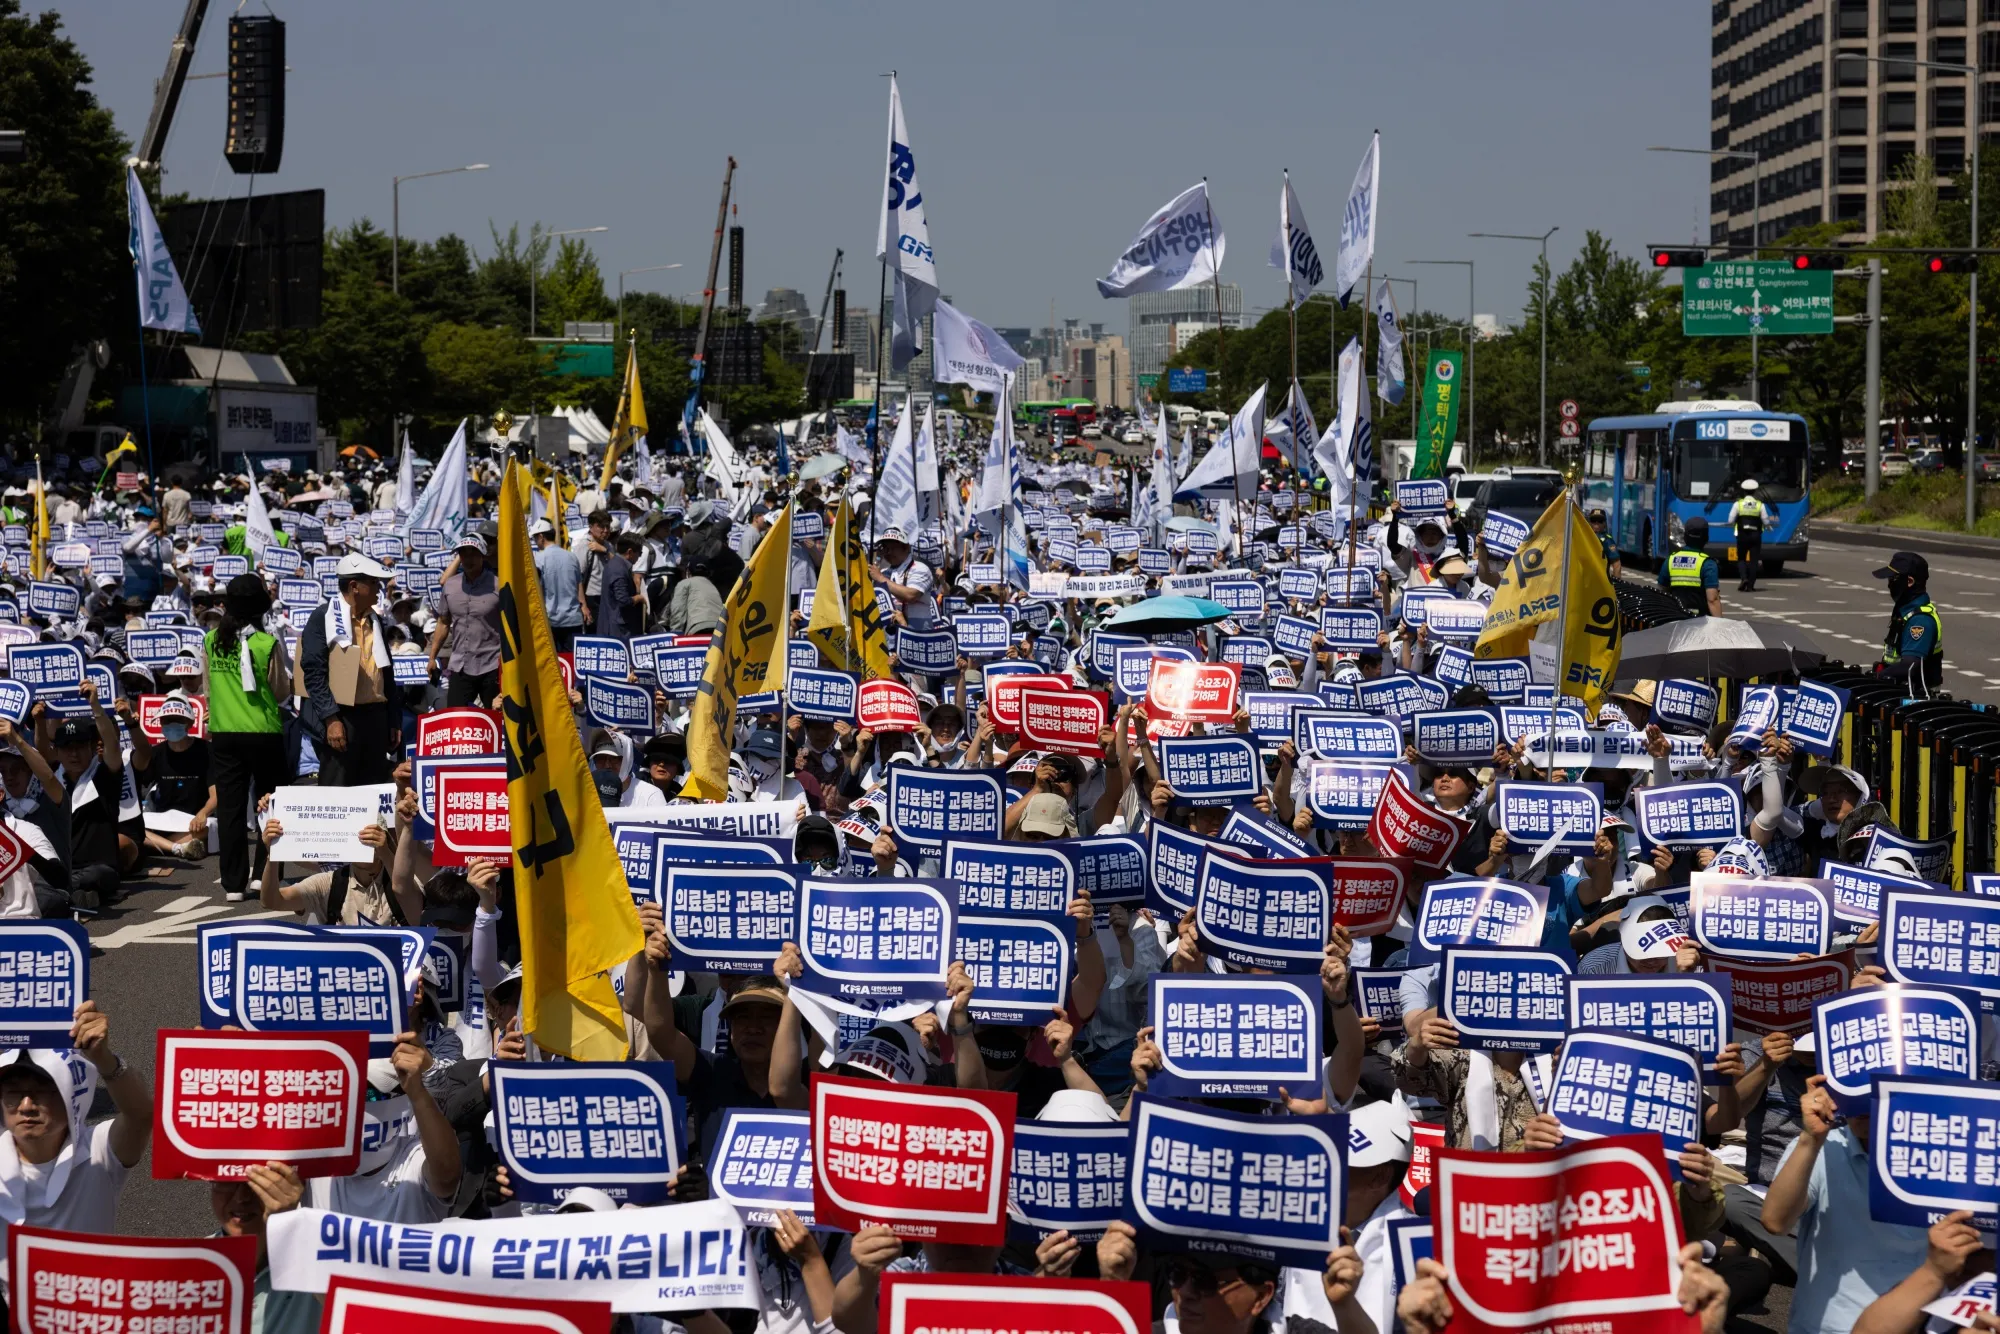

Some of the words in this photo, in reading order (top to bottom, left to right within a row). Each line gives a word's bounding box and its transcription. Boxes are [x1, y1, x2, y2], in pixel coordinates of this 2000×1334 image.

[1712, 264, 1735, 276] 시청
[1759, 267, 1775, 275] City
[1714, 277, 1755, 288] 강변북로
[1687, 300, 1732, 311] 국회의사당
[1782, 297, 1830, 308] 여의나루역
[1699, 423, 1725, 438] 160
[1325, 617, 1350, 627] 의료농단
[1352, 618, 1376, 628] 교육농단
[1325, 628, 1350, 638] 필수의료
[1352, 629, 1376, 639] 붕괴된다
[14, 656, 41, 670] 의료농단
[44, 654, 77, 668] 교육농단
[576, 646, 598, 658] 의료농단
[599, 648, 626, 660] 교육농단
[15, 670, 43, 683] 필수의료
[46, 668, 78, 682] 붕괴된다
[576, 659, 598, 670] 필수의료
[599, 660, 626, 673] 붕괴된다
[792, 678, 821, 692] 의료농단
[823, 682, 852, 695] 교육농단
[1196, 678, 1230, 688] 수요조사
[1663, 686, 1694, 702] 의료농단
[592, 687, 614, 702] 의료농단
[616, 694, 646, 707] 교육농단
[792, 690, 821, 705] 필수의료
[822, 694, 850, 708] 붕괴된다
[1661, 700, 1691, 715] 필수의료
[1800, 694, 1835, 717] 교육농단
[592, 700, 614, 717] 필수의료
[616, 706, 646, 720] 붕괴된다
[1028, 703, 1061, 717] 일방적인
[1063, 705, 1097, 721] 정책추진
[1028, 718, 1061, 732] 국민건강
[1063, 719, 1096, 735] 위협한다
[1317, 726, 1352, 738] 의료농단
[1356, 728, 1393, 740] 교육농단
[1421, 725, 1455, 739] 의료농단
[1458, 722, 1492, 737] 교육농단
[1795, 713, 1831, 734] 붕괴된다
[425, 728, 450, 746] 비과학적
[452, 727, 492, 741] 수요조사
[1318, 738, 1355, 751] 필수의료
[1358, 739, 1395, 752] 붕괴된다
[1421, 740, 1455, 752] 필수의료
[1457, 737, 1494, 751] 붕괴된다
[1169, 753, 1206, 768] 의료농단
[1209, 751, 1248, 767] 교육농단
[1170, 770, 1208, 785] 필수의료
[1212, 767, 1250, 784] 붕괴된다
[898, 786, 945, 809] 의료농단
[948, 791, 995, 810] 교육농단
[1647, 799, 1689, 817] 의료농단
[1691, 796, 1732, 813] 교육농단
[898, 807, 944, 831] 필수의료
[948, 812, 996, 831] 붕괴된다
[1649, 815, 1691, 834] 필수의료
[1694, 814, 1734, 832] 붕괴된다
[954, 861, 1007, 885] 의료농단
[1011, 866, 1065, 888] 교육농단
[1833, 873, 1881, 895] 의료농단
[675, 889, 731, 913] 의료농단
[736, 890, 795, 914] 교육농단
[1207, 876, 1260, 910] 의료농단
[1264, 890, 1321, 914] 교육농단
[812, 904, 875, 931] 의료농단
[878, 907, 940, 933] 교육농단
[1705, 895, 1760, 918] 의료농단
[1764, 897, 1819, 922] 교육농단
[1203, 902, 1258, 934] 필수의료
[1262, 913, 1322, 940] 붕괴된다
[1705, 916, 1760, 941] 필수의료
[1764, 919, 1819, 945] 붕괴된다
[811, 931, 874, 960] 필수의료
[878, 934, 939, 961] 붕괴된다
[248, 966, 312, 992] 의료농단
[318, 966, 385, 993] 교육농단
[840, 983, 870, 995] KMA
[248, 996, 316, 1021] 필수의료
[321, 996, 388, 1021] 붕괴된다
[1167, 1003, 1233, 1028] 의료농단
[1239, 1003, 1303, 1030] 교육농단
[1582, 1001, 1646, 1026] 의료농단
[1651, 1001, 1715, 1025] 교육농단
[1830, 1013, 1894, 1048] 의료농단
[1901, 1011, 1967, 1044] 교육농단
[1167, 1032, 1232, 1058] 필수의료
[1238, 1032, 1305, 1059] 붕괴된다
[180, 1069, 260, 1096] 일방적인
[264, 1069, 343, 1096] 정책추진
[1201, 1083, 1232, 1094] KMA
[1559, 1056, 1632, 1087] 의료농단
[1635, 1068, 1699, 1106] 교육농단
[178, 1101, 259, 1128] 국민건강
[263, 1101, 342, 1128] 위협한다
[509, 1095, 578, 1125] 의료농단
[585, 1095, 657, 1125] 교육농단
[1553, 1084, 1629, 1126] 필수의료
[1631, 1099, 1698, 1141] 붕괴된다
[829, 1115, 901, 1152] 일방적인
[905, 1125, 987, 1158] 정책추진
[1890, 1110, 1970, 1147] 의료농단
[511, 1129, 584, 1159] 필수의료
[589, 1129, 662, 1158] 붕괴된다
[729, 1134, 798, 1162] 의료농단
[828, 1148, 899, 1186] 국민건강
[901, 1159, 985, 1192] 위협한다
[1148, 1136, 1234, 1181] 의료농단
[1240, 1152, 1327, 1188] 교육농단
[1891, 1146, 1968, 1183] 필수의료
[722, 1159, 791, 1188] 필수의료
[1146, 1174, 1232, 1216] 필수의료
[1238, 1189, 1327, 1225] 붕괴된다
[1459, 1201, 1557, 1240] 비과학적
[1557, 1185, 1655, 1231] 수요조사
[317, 1214, 475, 1273] 의사들이
[492, 1229, 746, 1280] 살리겠습니다!
[34, 1271, 124, 1309] 일방적인
[128, 1279, 225, 1310] 정책추진
